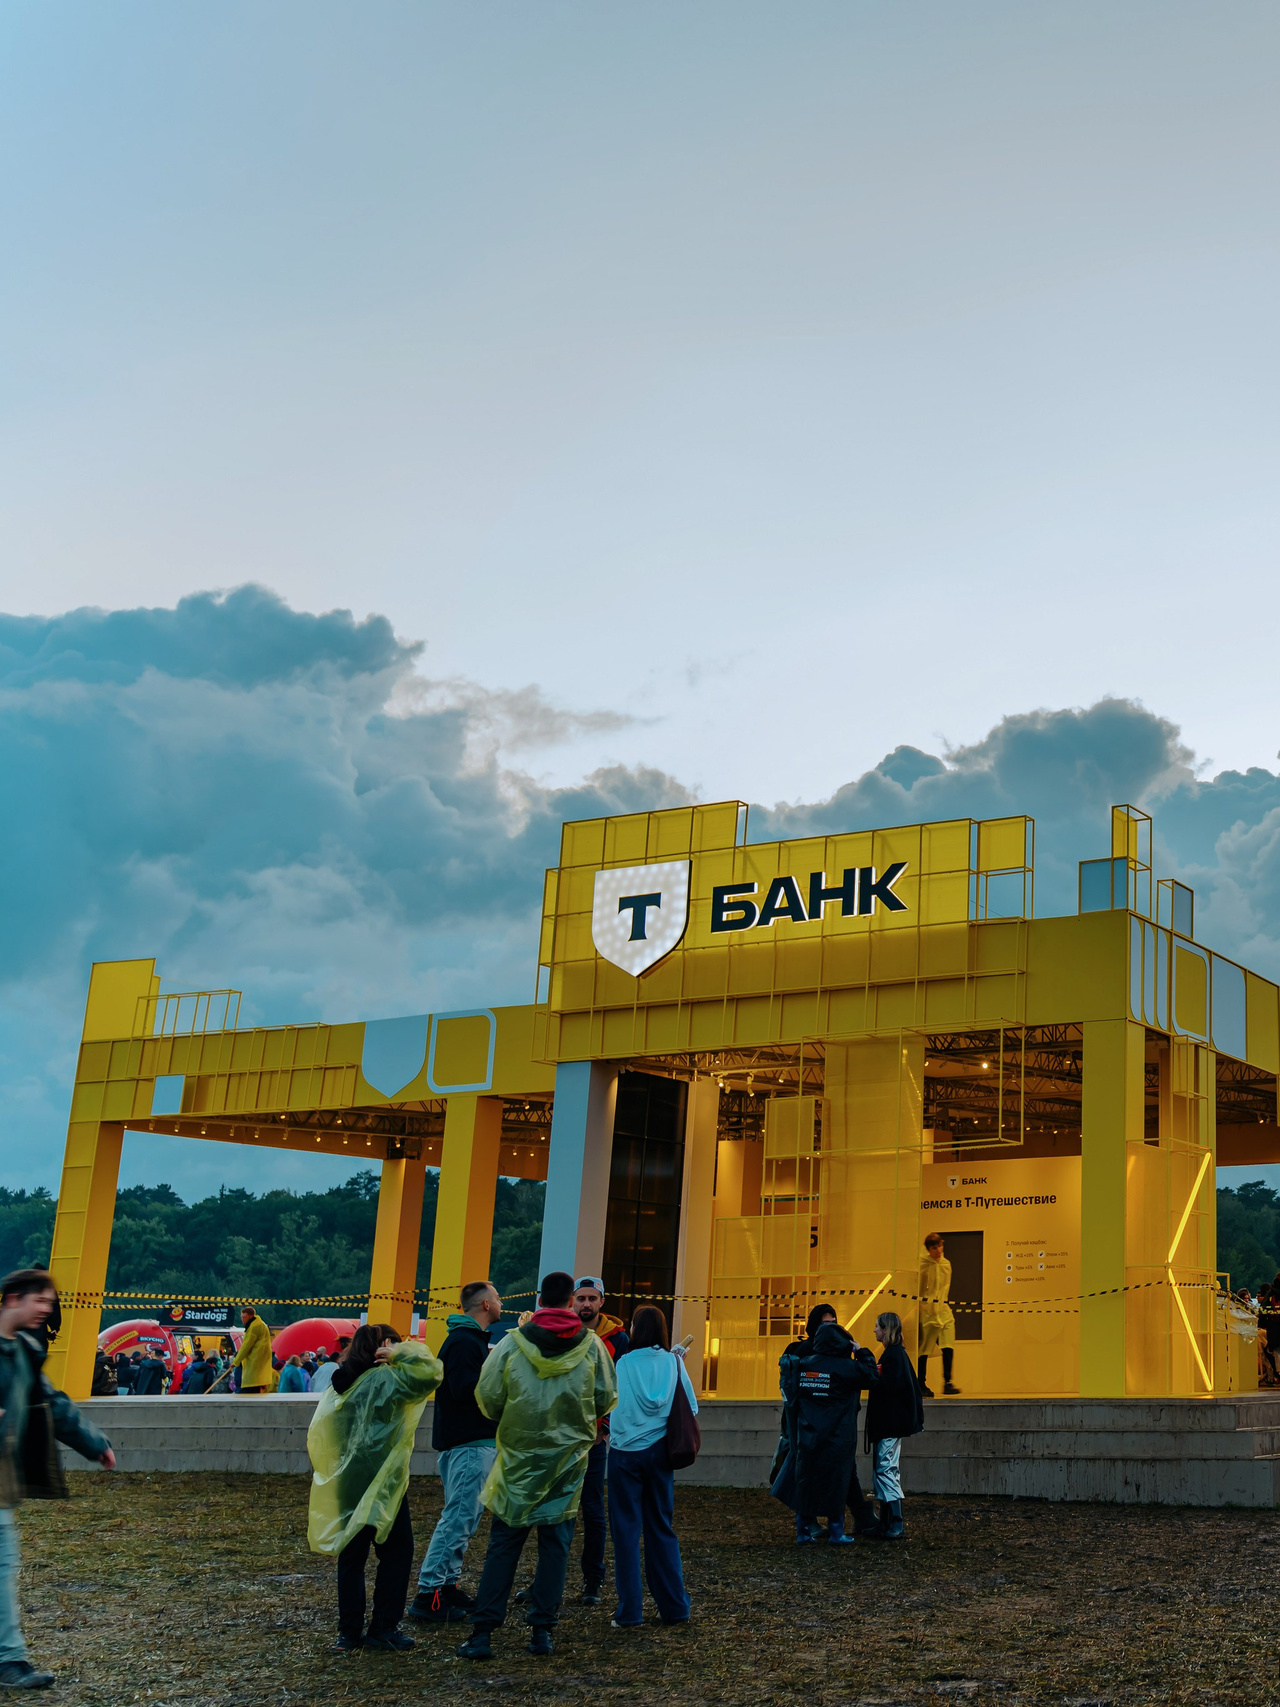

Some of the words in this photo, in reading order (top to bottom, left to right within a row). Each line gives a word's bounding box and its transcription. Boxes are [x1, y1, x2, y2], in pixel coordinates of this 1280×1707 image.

[711, 861, 909, 933] БАНК
[962, 1177, 988, 1185] БАНК
[955, 1200, 962, 1208] в
[965, 1194, 1057, 1210] Т-Путешествие
[185, 1309, 227, 1322] Stardogs
